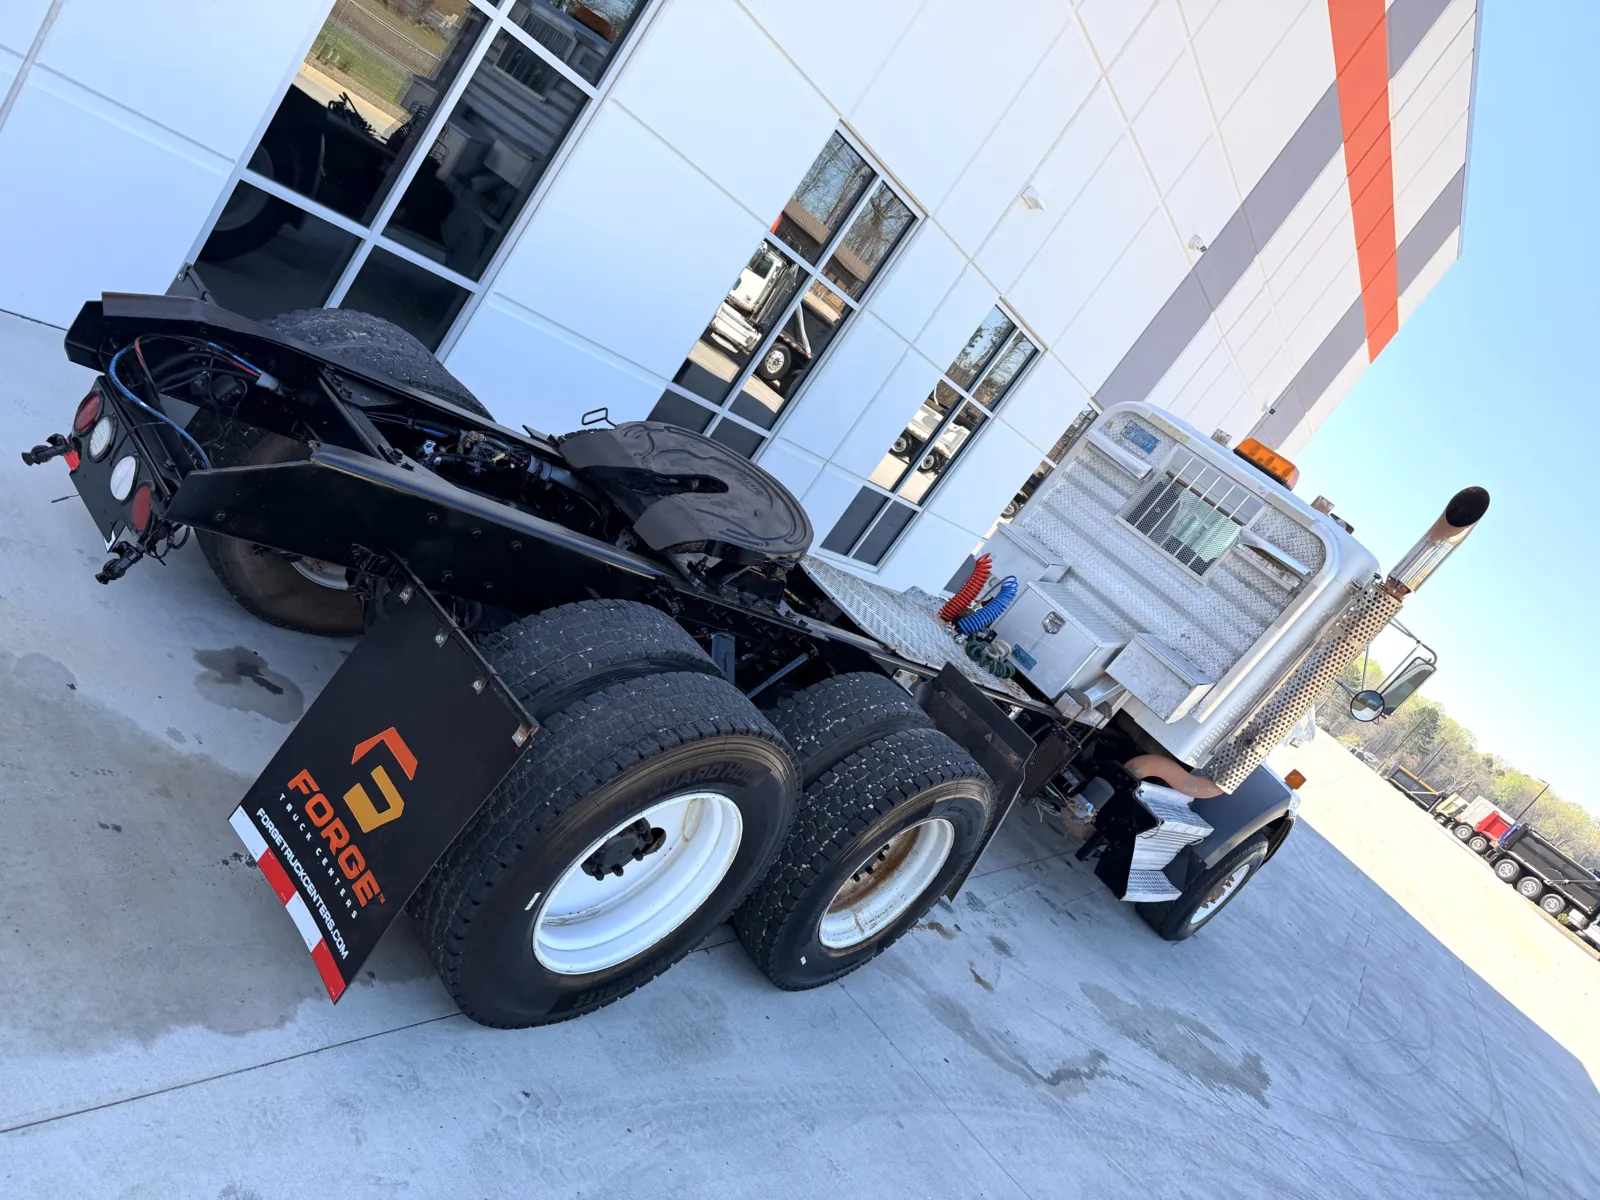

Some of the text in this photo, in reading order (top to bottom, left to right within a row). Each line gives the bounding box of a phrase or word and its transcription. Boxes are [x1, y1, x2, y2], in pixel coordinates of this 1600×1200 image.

[256, 807, 349, 960] FORGETRUCKCENTERS.COM
[279, 792, 358, 919] TRUCK CENTERS
[287, 768, 381, 908] FORGE
